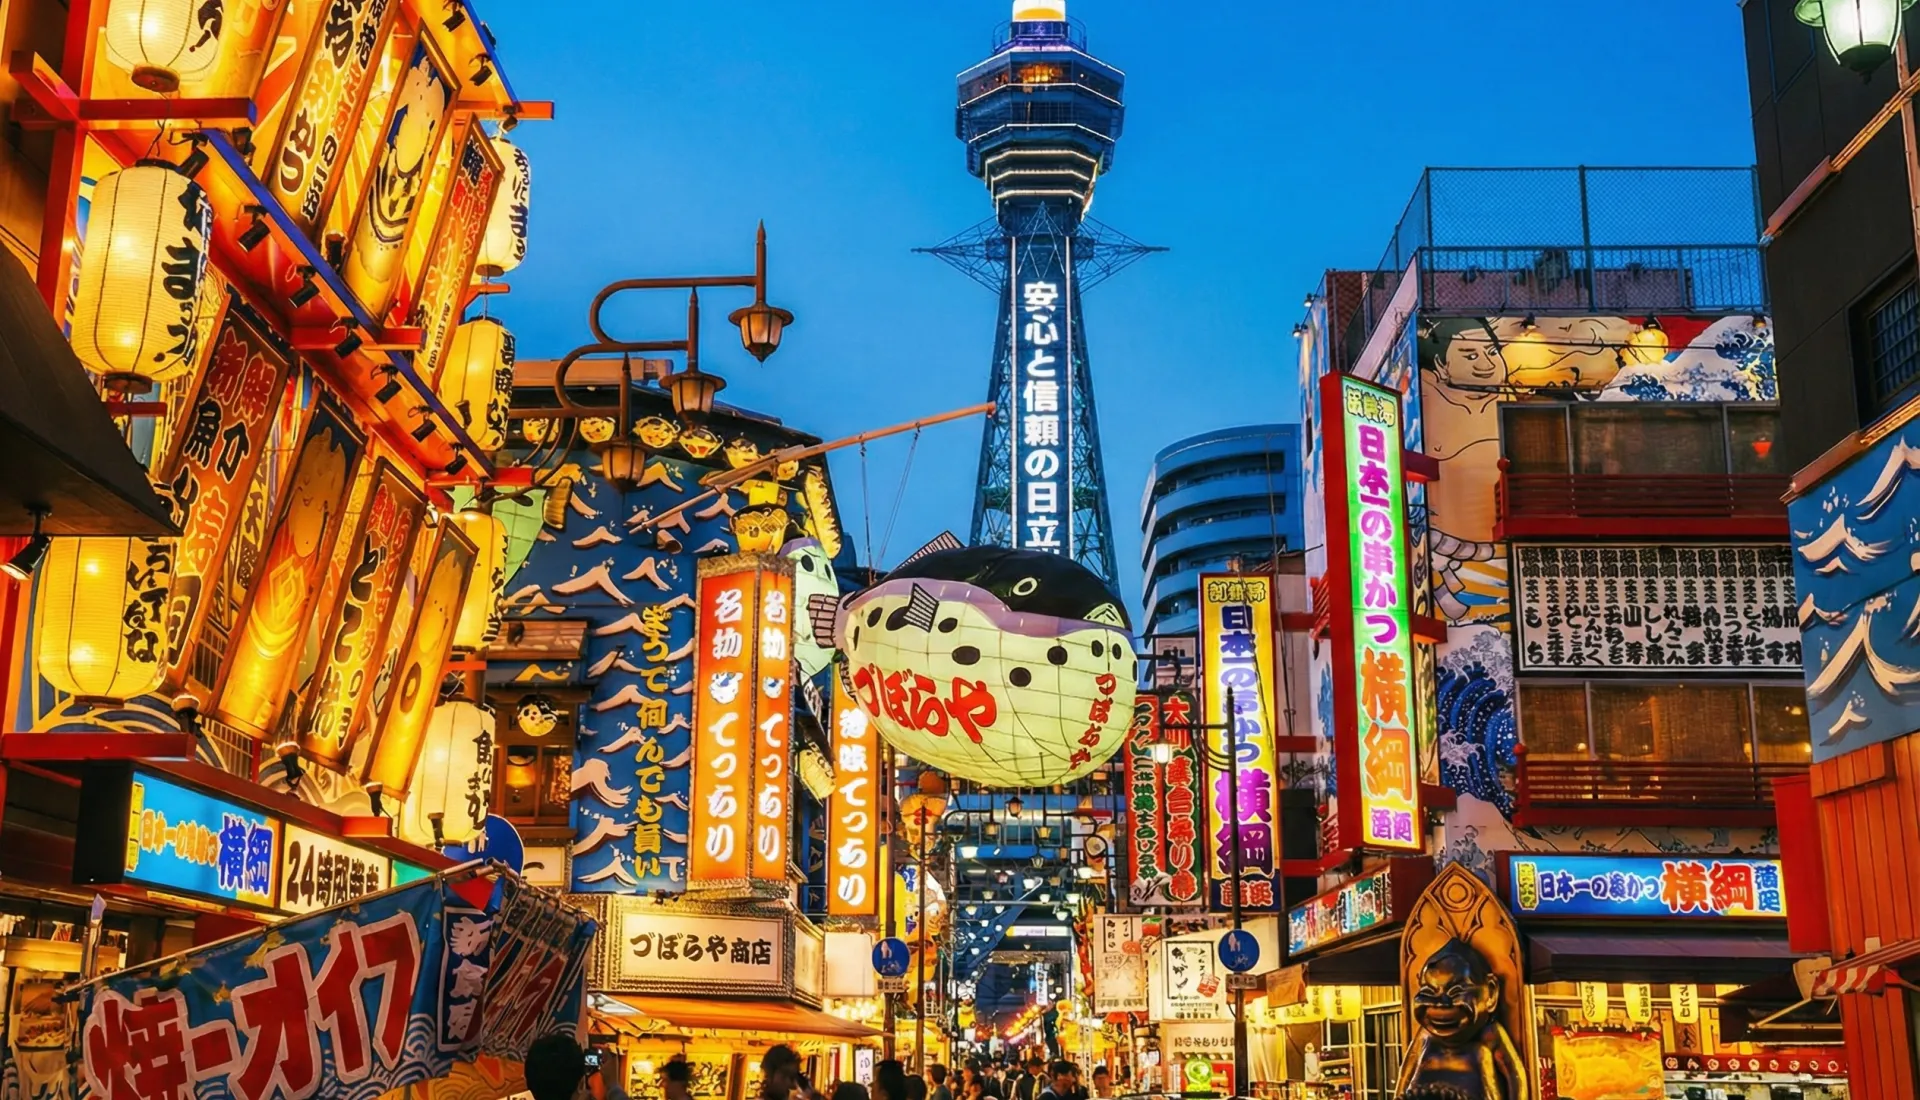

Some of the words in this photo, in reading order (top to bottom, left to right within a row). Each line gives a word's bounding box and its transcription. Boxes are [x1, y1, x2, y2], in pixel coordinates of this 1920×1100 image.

[1023, 281, 1061, 555] 安心と信頼の日立
[713, 589, 742, 660] 名物
[630, 931, 772, 965] づぼらや商店
